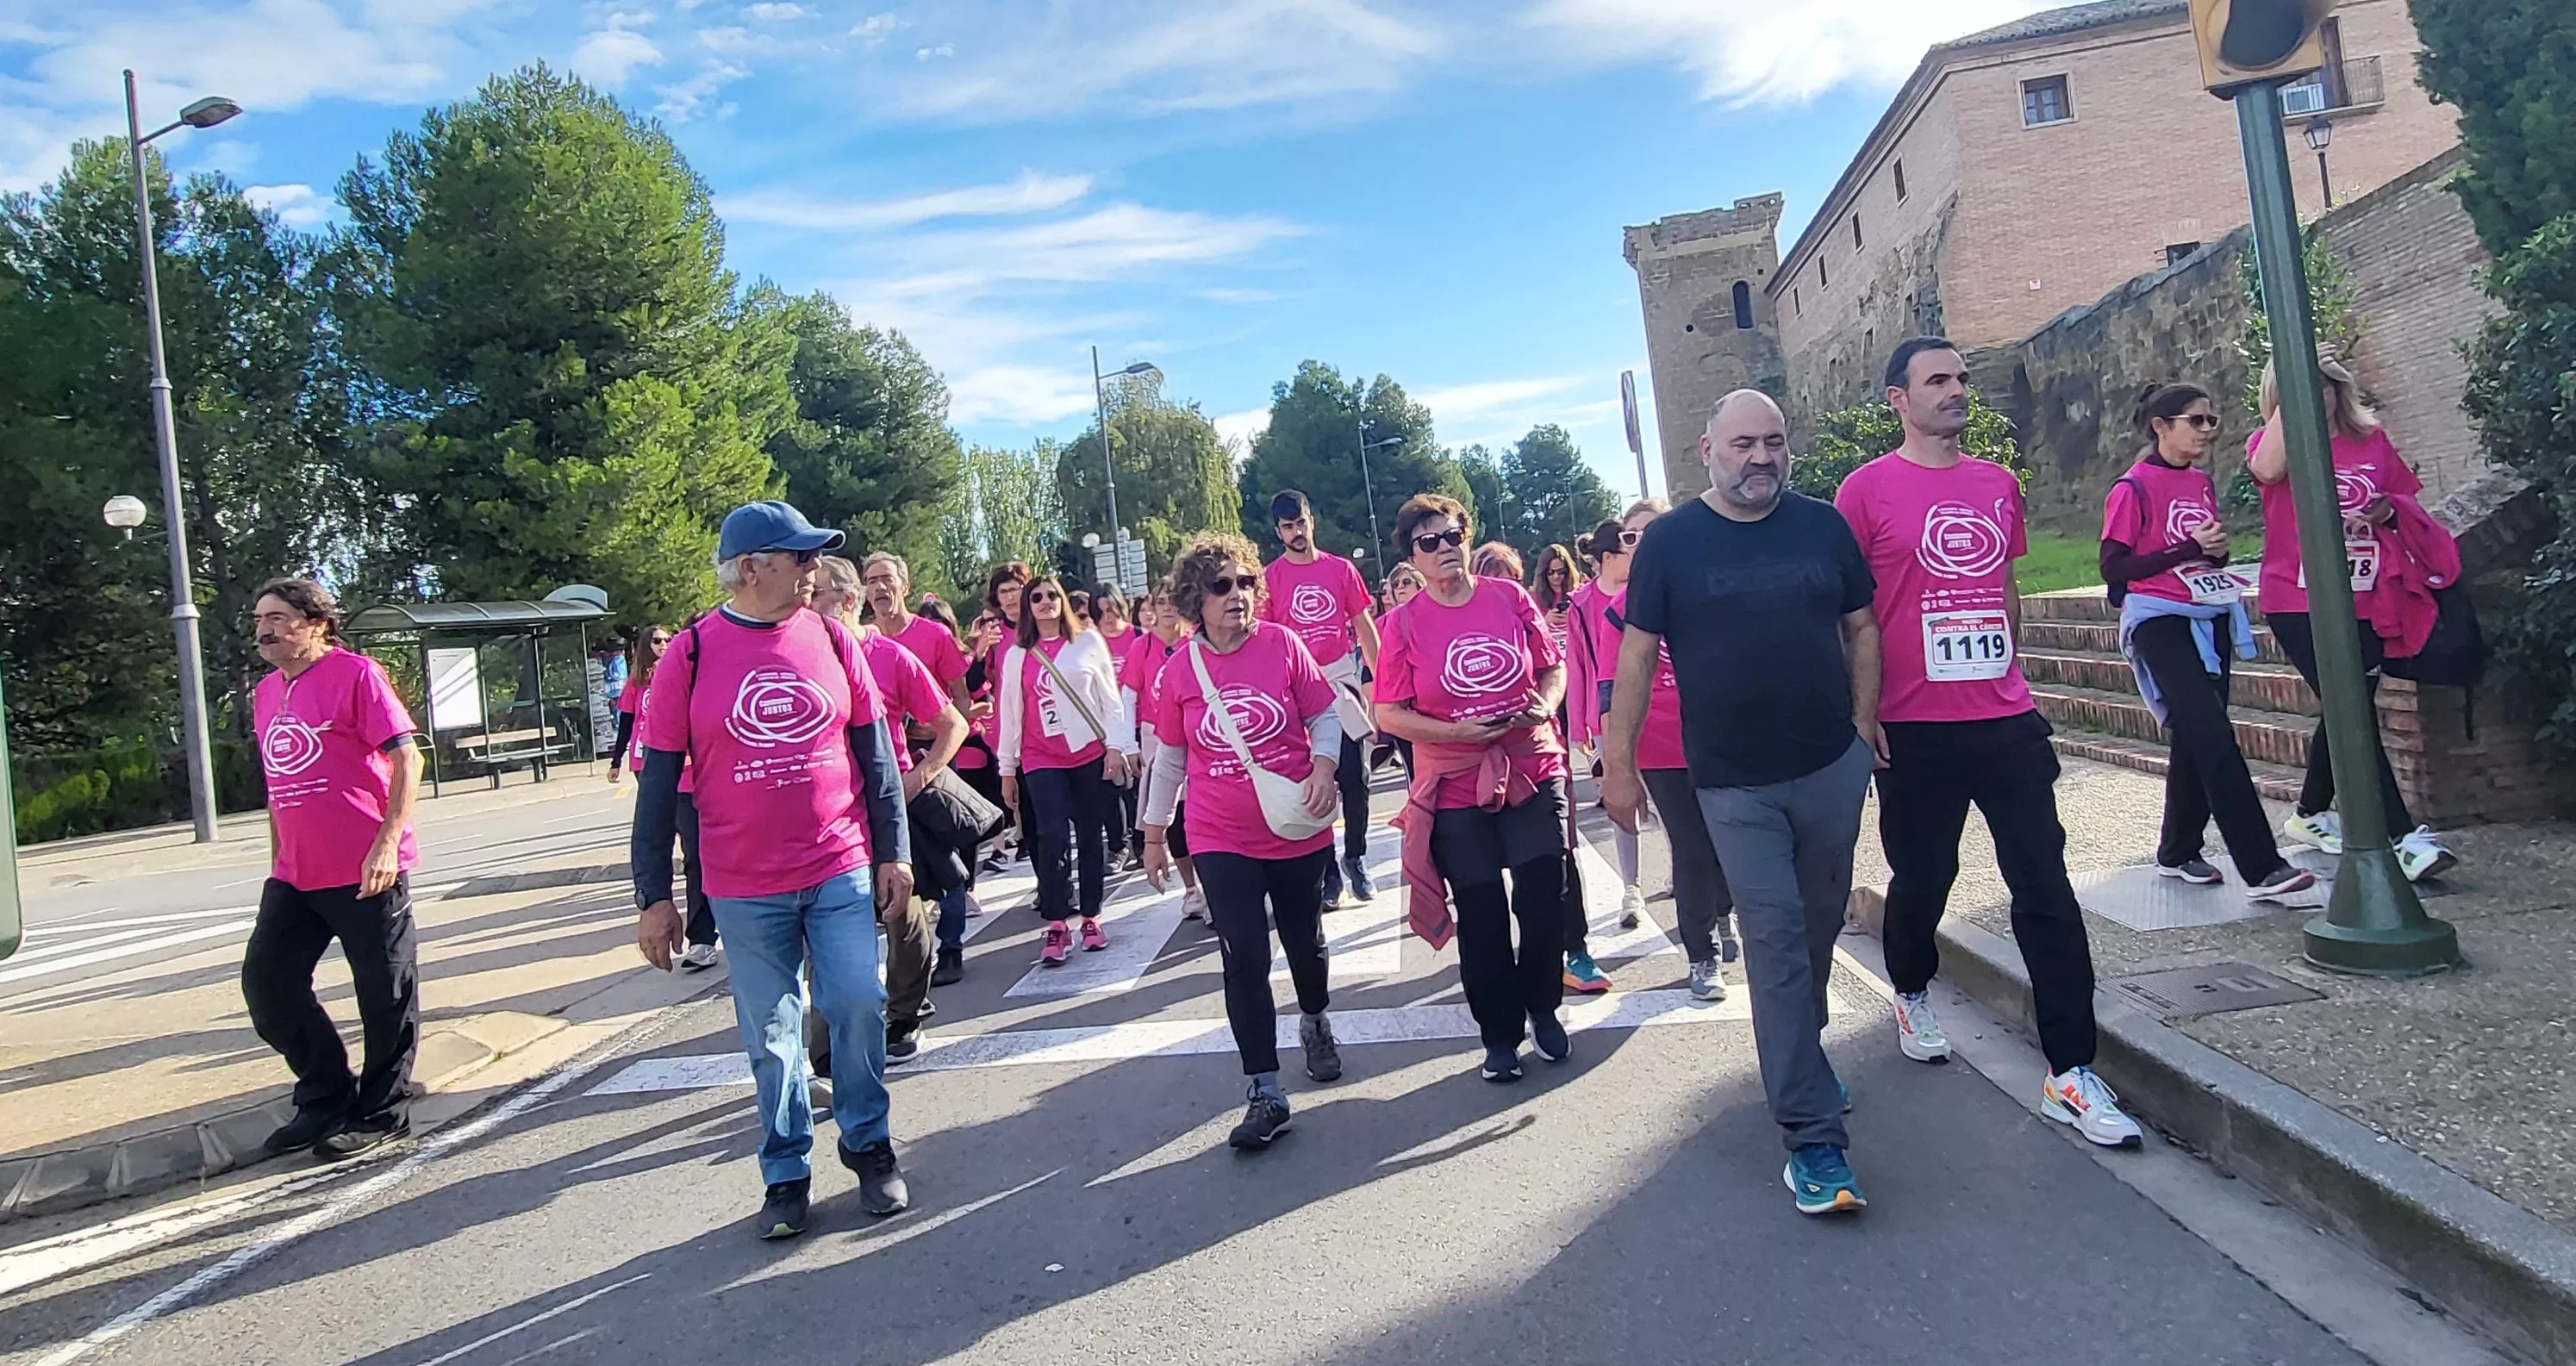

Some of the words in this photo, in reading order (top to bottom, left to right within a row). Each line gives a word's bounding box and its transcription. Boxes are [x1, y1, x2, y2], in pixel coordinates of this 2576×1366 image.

[2348, 558, 2372, 577] 18
[2193, 574, 2235, 594] 1925
[1936, 633, 2005, 661] 1119
[762, 702, 794, 716] JUNTOS
[1046, 710, 1059, 725] 2
